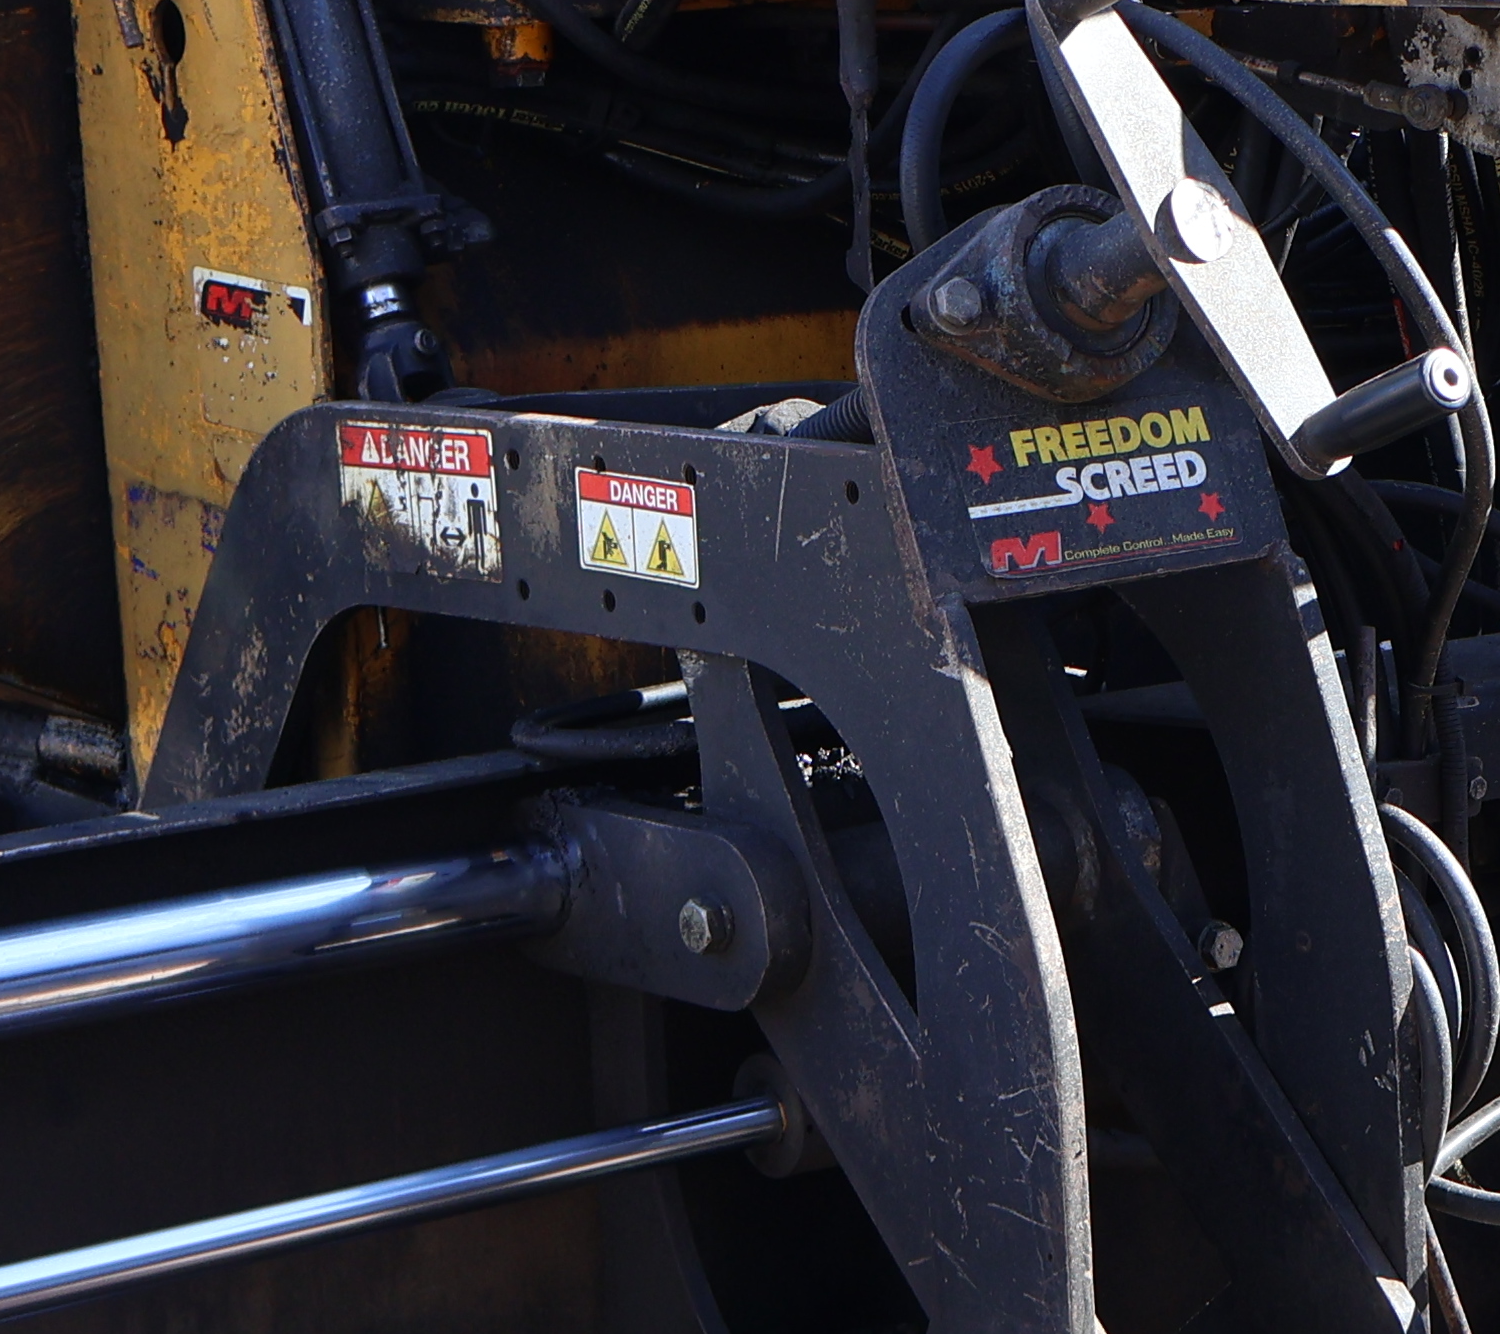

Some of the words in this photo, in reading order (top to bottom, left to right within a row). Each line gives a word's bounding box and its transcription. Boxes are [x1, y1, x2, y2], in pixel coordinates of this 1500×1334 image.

[1454, 193, 1476, 237] MSHA
[1009, 406, 1211, 468] FREEDOM
[609, 479, 679, 512] DANGER
[1055, 450, 1207, 505] SCREED
[1064, 543, 1121, 562] Complete
[1205, 526, 1235, 541] Easy
